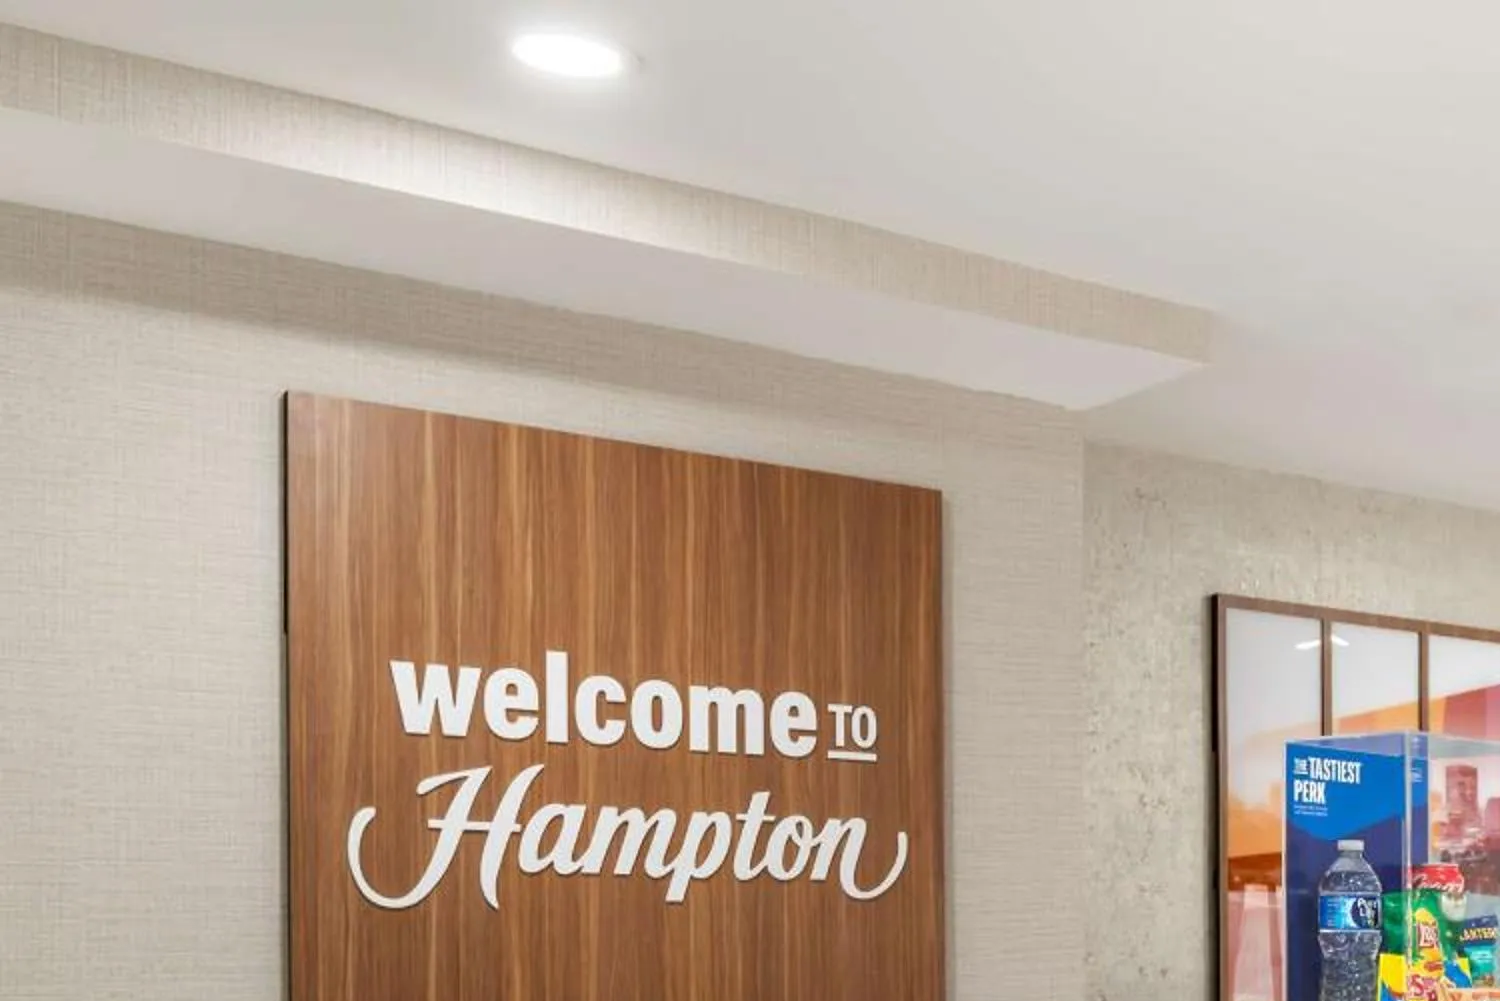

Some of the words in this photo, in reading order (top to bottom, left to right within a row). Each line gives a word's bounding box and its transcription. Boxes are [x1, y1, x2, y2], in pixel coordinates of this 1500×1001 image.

[389, 650, 818, 757] welcome
[827, 703, 877, 750] TO
[1294, 780, 1326, 804] PERK
[1308, 756, 1362, 784] TASTIEST
[346, 764, 908, 910] Hampton
